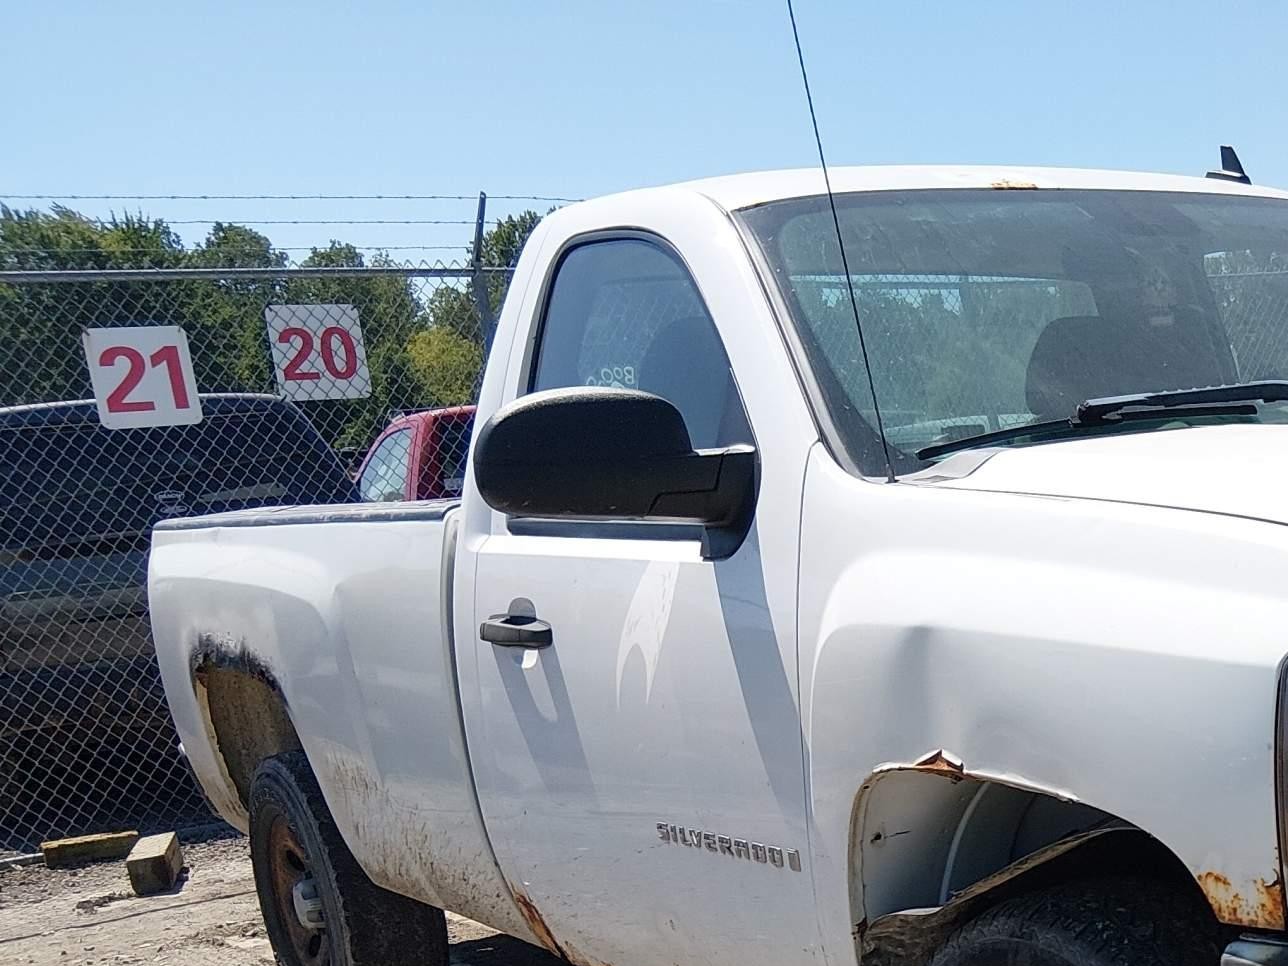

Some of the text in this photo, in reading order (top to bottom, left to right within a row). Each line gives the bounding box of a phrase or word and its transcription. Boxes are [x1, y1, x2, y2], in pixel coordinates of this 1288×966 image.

[98, 345, 190, 413] 21
[278, 326, 358, 381] 20
[656, 821, 784, 868] SILVERADO
